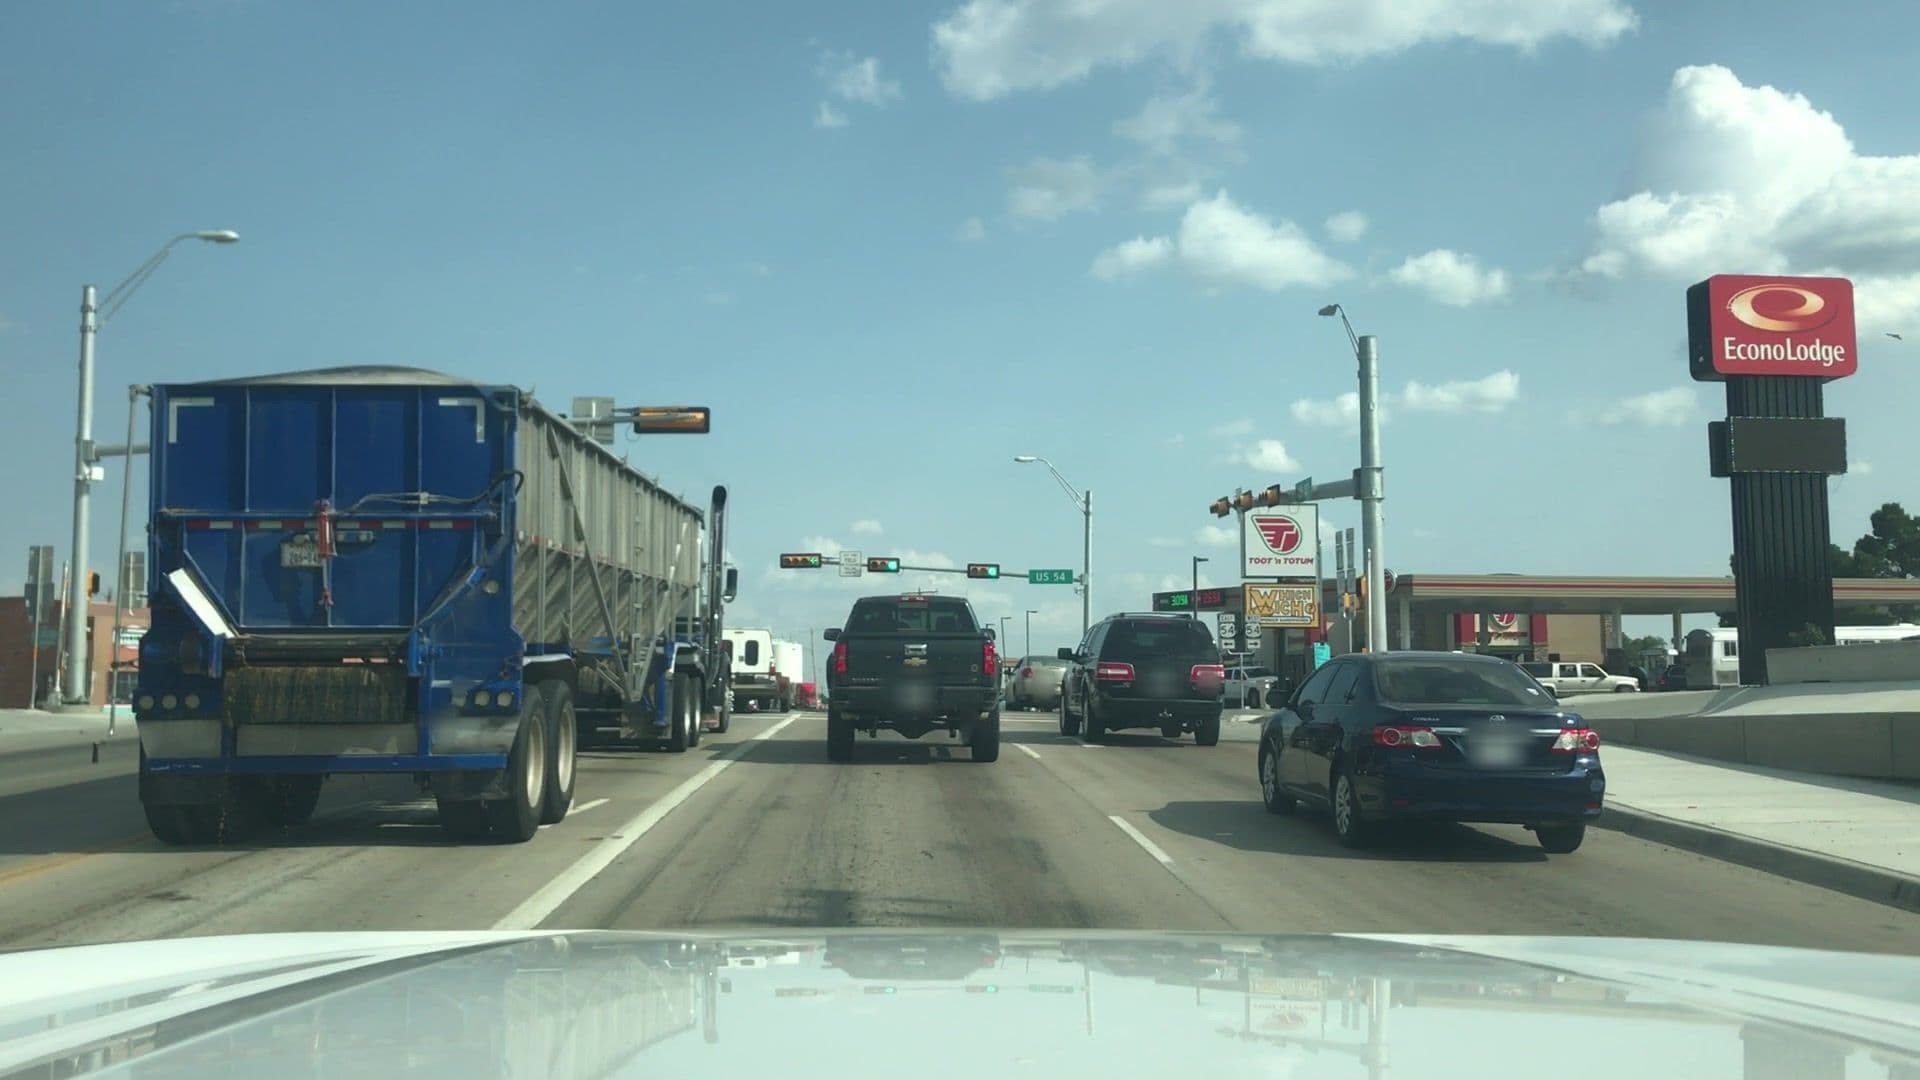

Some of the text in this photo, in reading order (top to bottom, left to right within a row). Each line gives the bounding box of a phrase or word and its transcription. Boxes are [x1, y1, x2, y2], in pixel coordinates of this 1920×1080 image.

[1724, 337, 1845, 367] EconoLodge
[1248, 557, 1273, 565] TOOT
[1283, 557, 1313, 565] TOTUM
[1036, 571, 1065, 582] US 54
[1221, 625, 1234, 635] 54
[1247, 625, 1260, 635] 54
